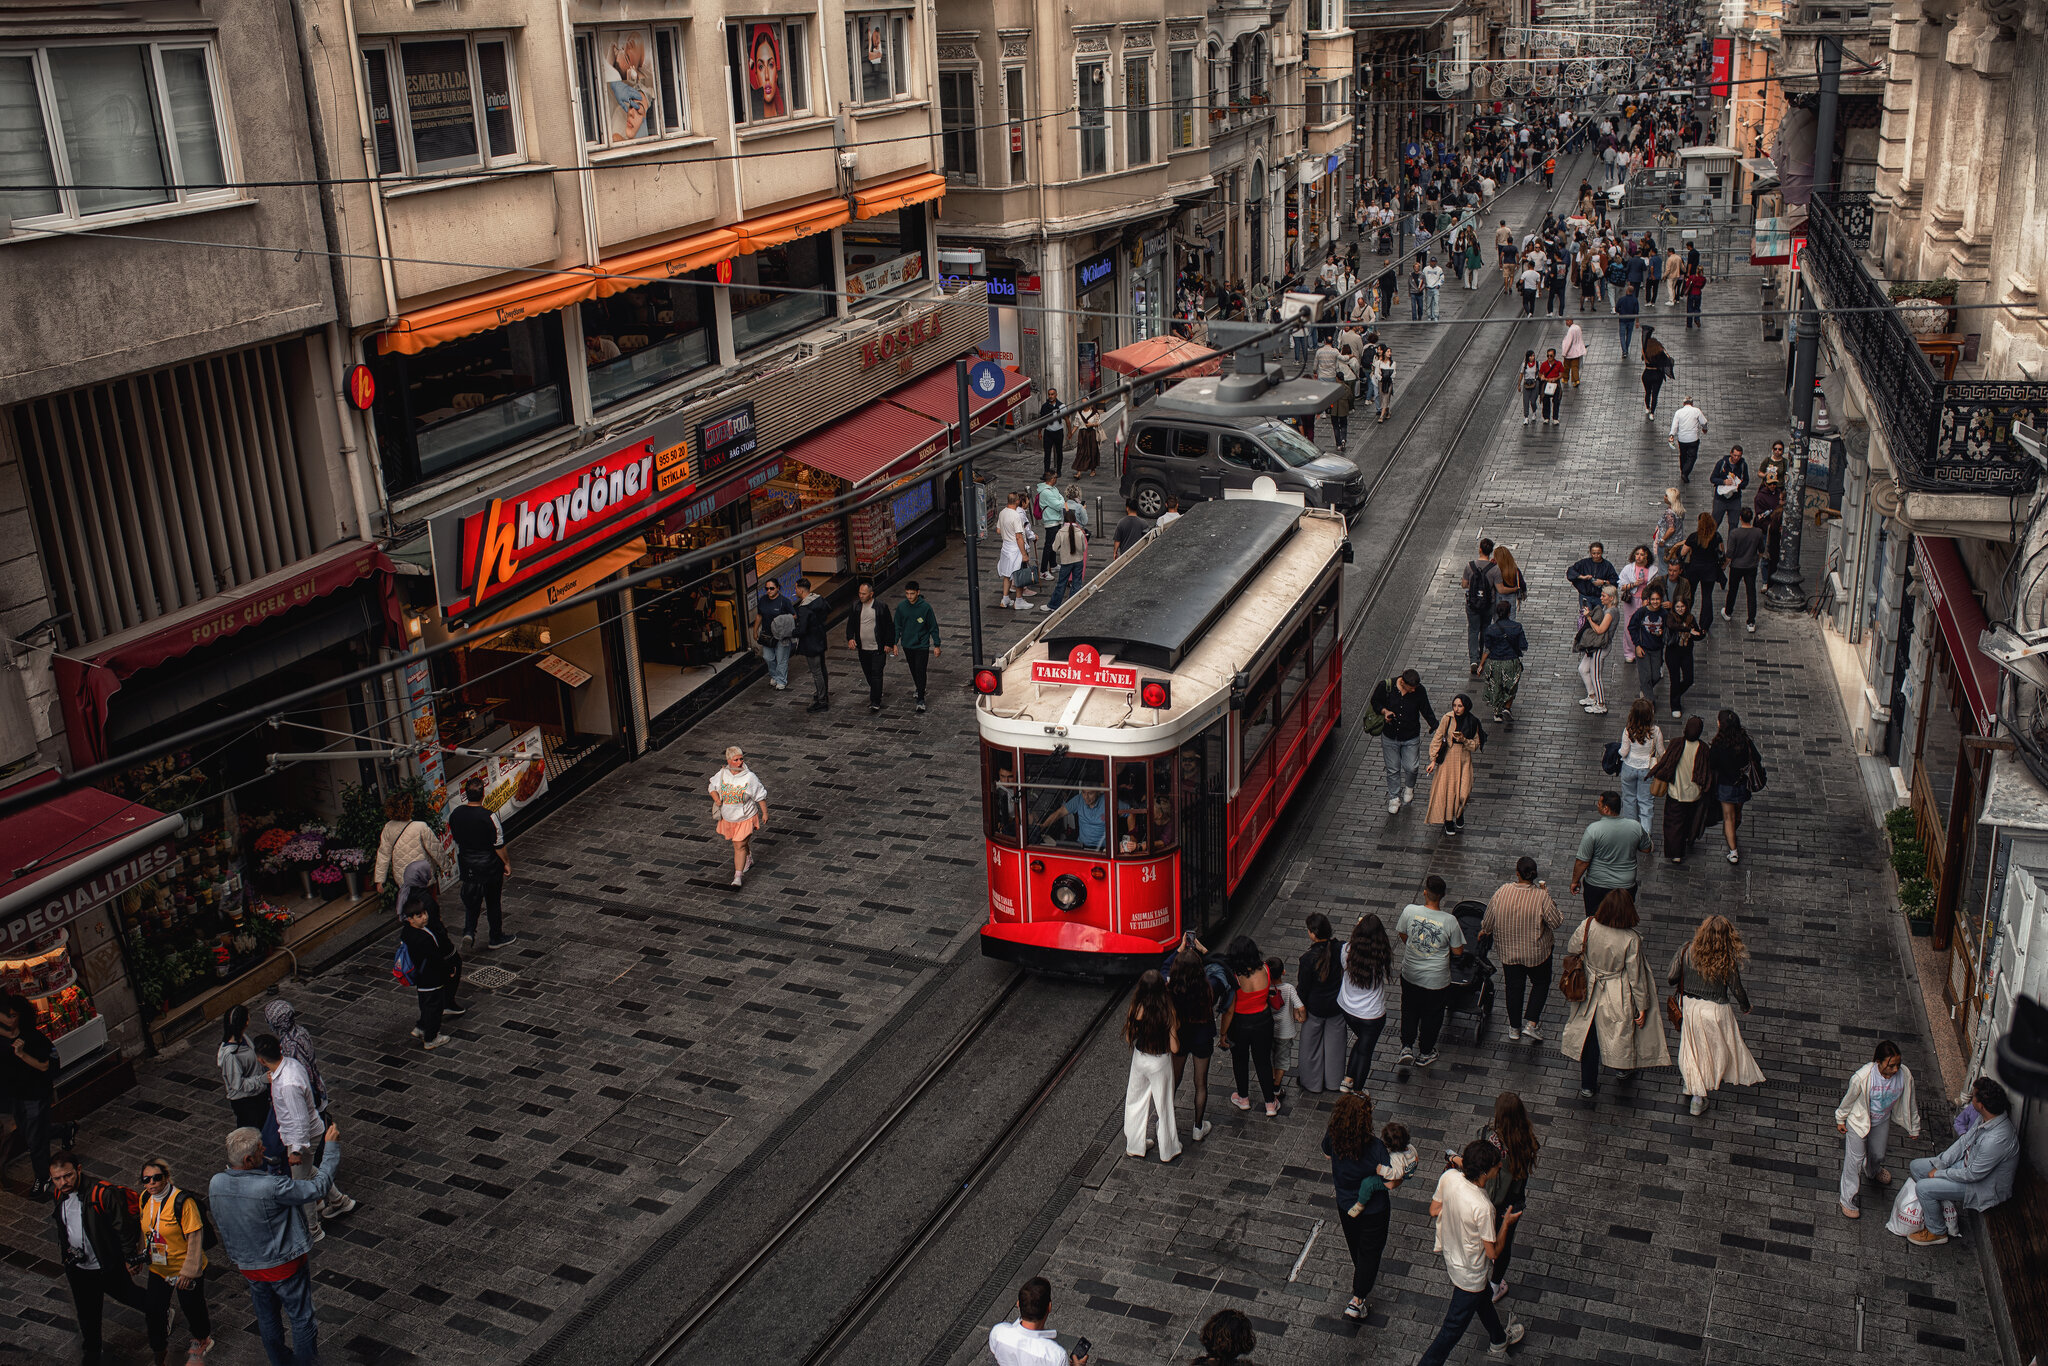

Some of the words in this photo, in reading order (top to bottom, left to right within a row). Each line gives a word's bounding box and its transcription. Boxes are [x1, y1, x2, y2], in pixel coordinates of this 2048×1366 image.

[406, 71, 469, 92] ESMERALDA
[486, 91, 509, 106] ininal
[374, 104, 389, 119] nal
[1089, 258, 1112, 282] Columbia
[866, 279, 877, 291] TACO
[890, 270, 902, 282] TACO
[861, 310, 942, 370] KOSKA
[358, 368, 371, 408] h
[1007, 392, 1022, 406] KOSKA
[659, 455, 670, 467] 955
[670, 451, 678, 461] 50
[678, 446, 686, 457] 20
[729, 447, 740, 459] BAG
[740, 439, 756, 454] STORE
[919, 443, 936, 461] KOSKA
[661, 467, 687, 487] İSTİKLAL
[517, 456, 652, 550] heydöner
[684, 495, 716, 525] DURU
[557, 578, 577, 595] heydöner
[191, 614, 235, 643] FOTİS
[243, 593, 287, 623] ÇİÇEK
[293, 577, 316, 600] EVİ
[1076, 652, 1092, 664] 34
[1036, 666, 1081, 680] TAKSİM
[1094, 670, 1133, 686] TÜNEL
[992, 847, 1002, 866] 34
[1141, 865, 1157, 883] 34
[1154, 907, 1169, 918] YASAK
[1129, 921, 1137, 930] VE
